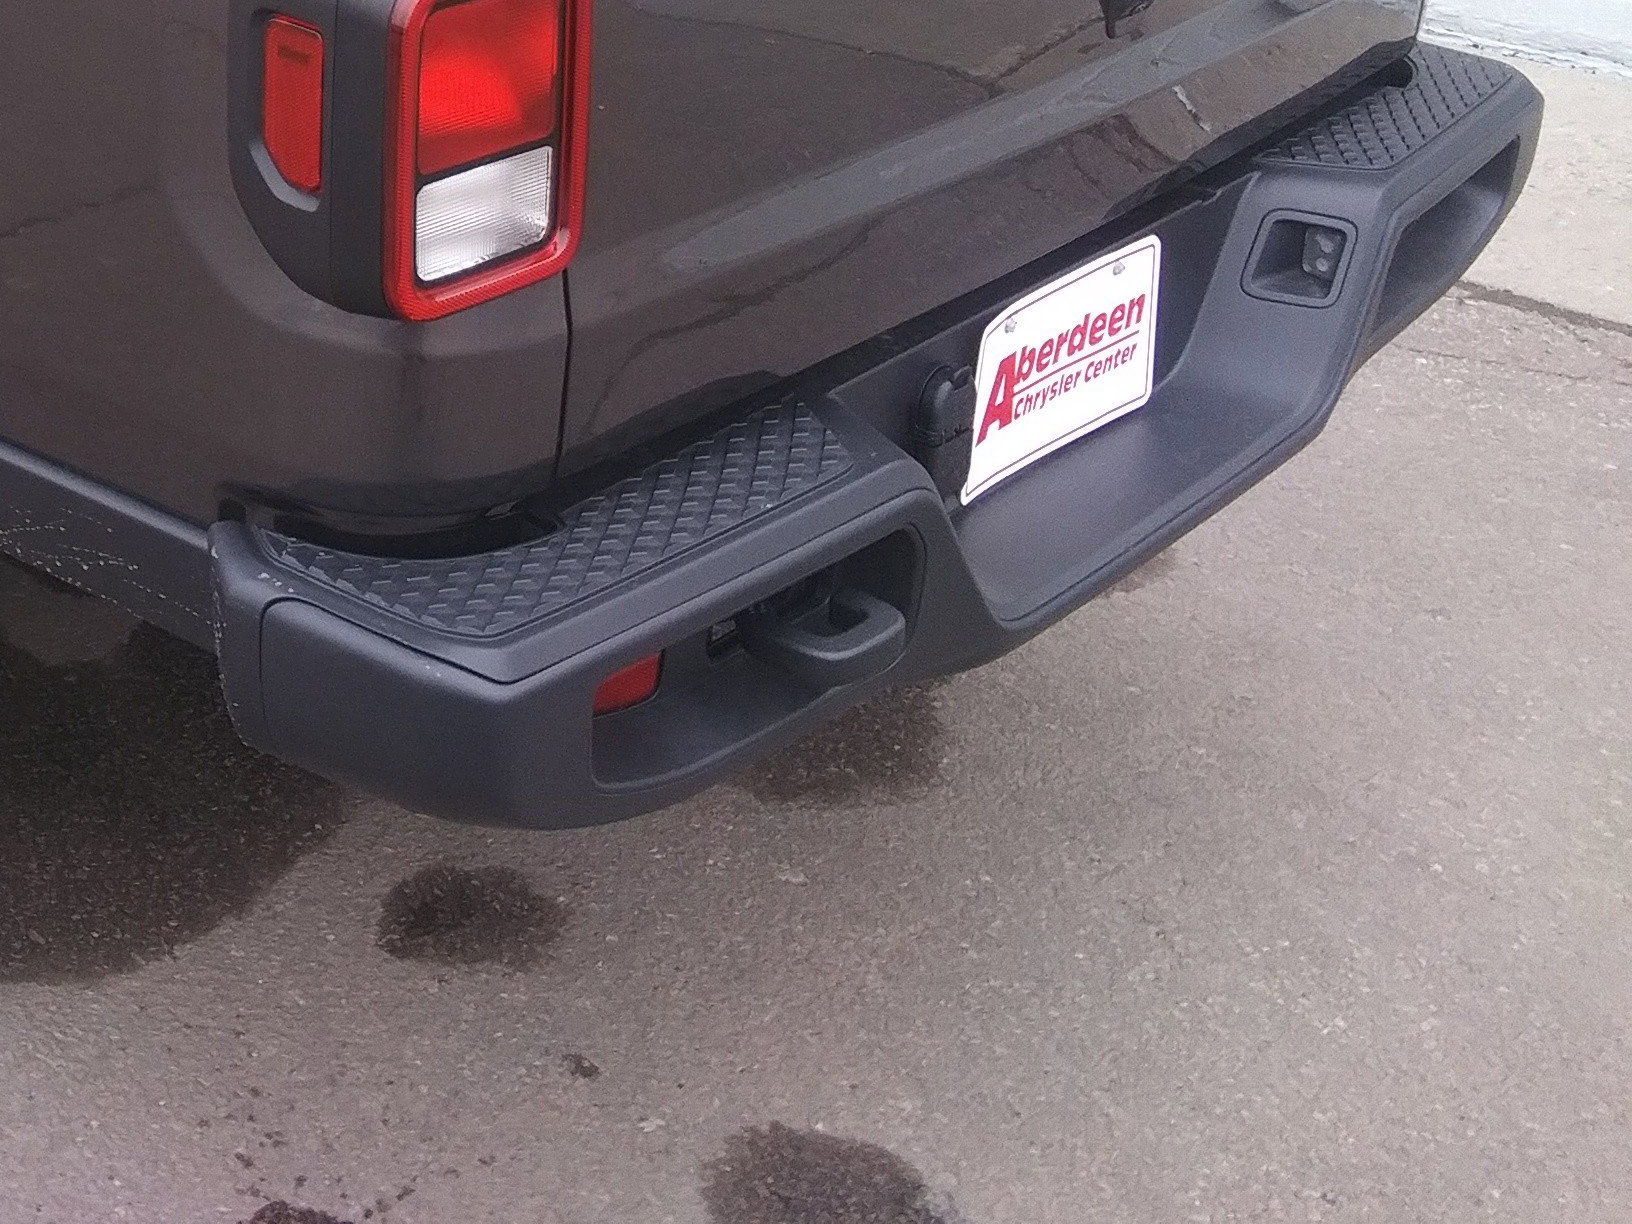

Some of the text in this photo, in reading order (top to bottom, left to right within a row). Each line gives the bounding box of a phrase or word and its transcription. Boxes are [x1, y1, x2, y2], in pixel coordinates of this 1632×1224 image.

[974, 292, 1146, 447] Aberdeen
[1013, 342, 1138, 421] Chrysler Center
